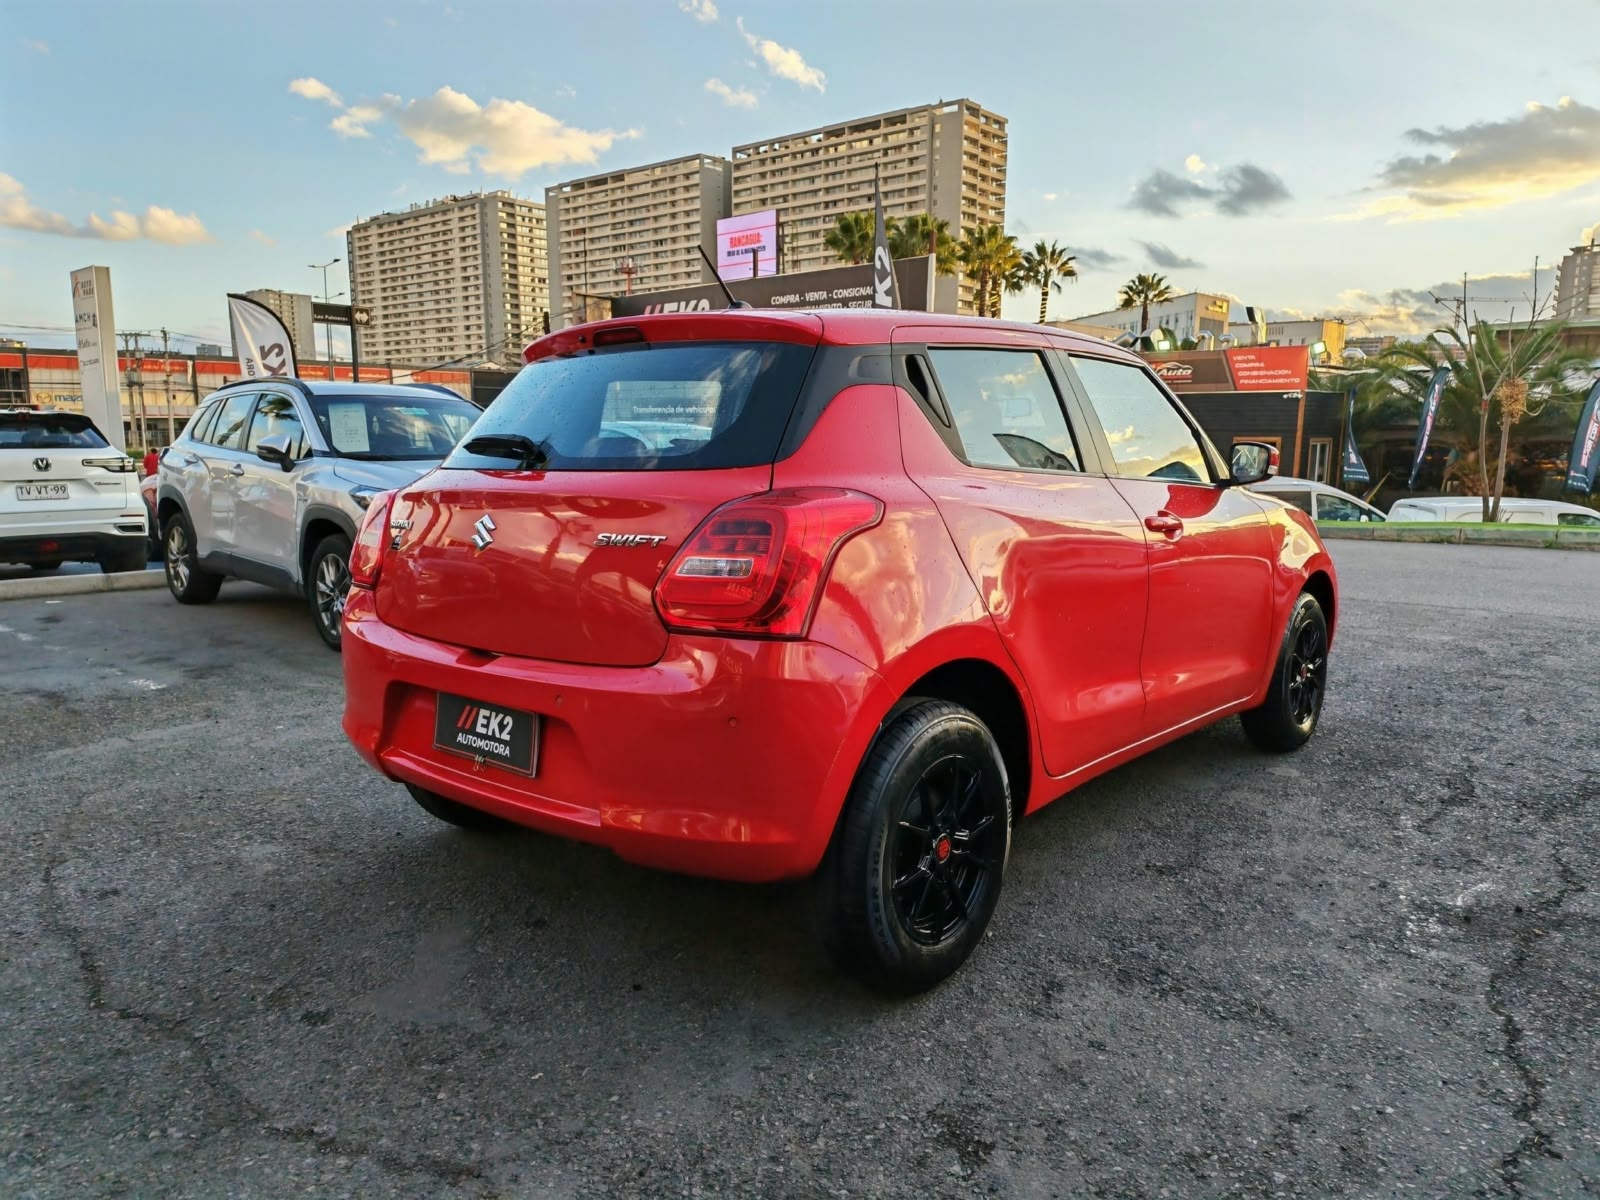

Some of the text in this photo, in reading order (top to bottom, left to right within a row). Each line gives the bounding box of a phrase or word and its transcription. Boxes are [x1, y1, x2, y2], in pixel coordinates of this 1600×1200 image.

[771, 294, 800, 305] COMPRA
[805, 291, 828, 302] VENTA
[1239, 377, 1301, 385] FINANCIAMIENTO
[593, 532, 668, 548] SWIFT
[456, 731, 511, 757] AUTOMOTORA
